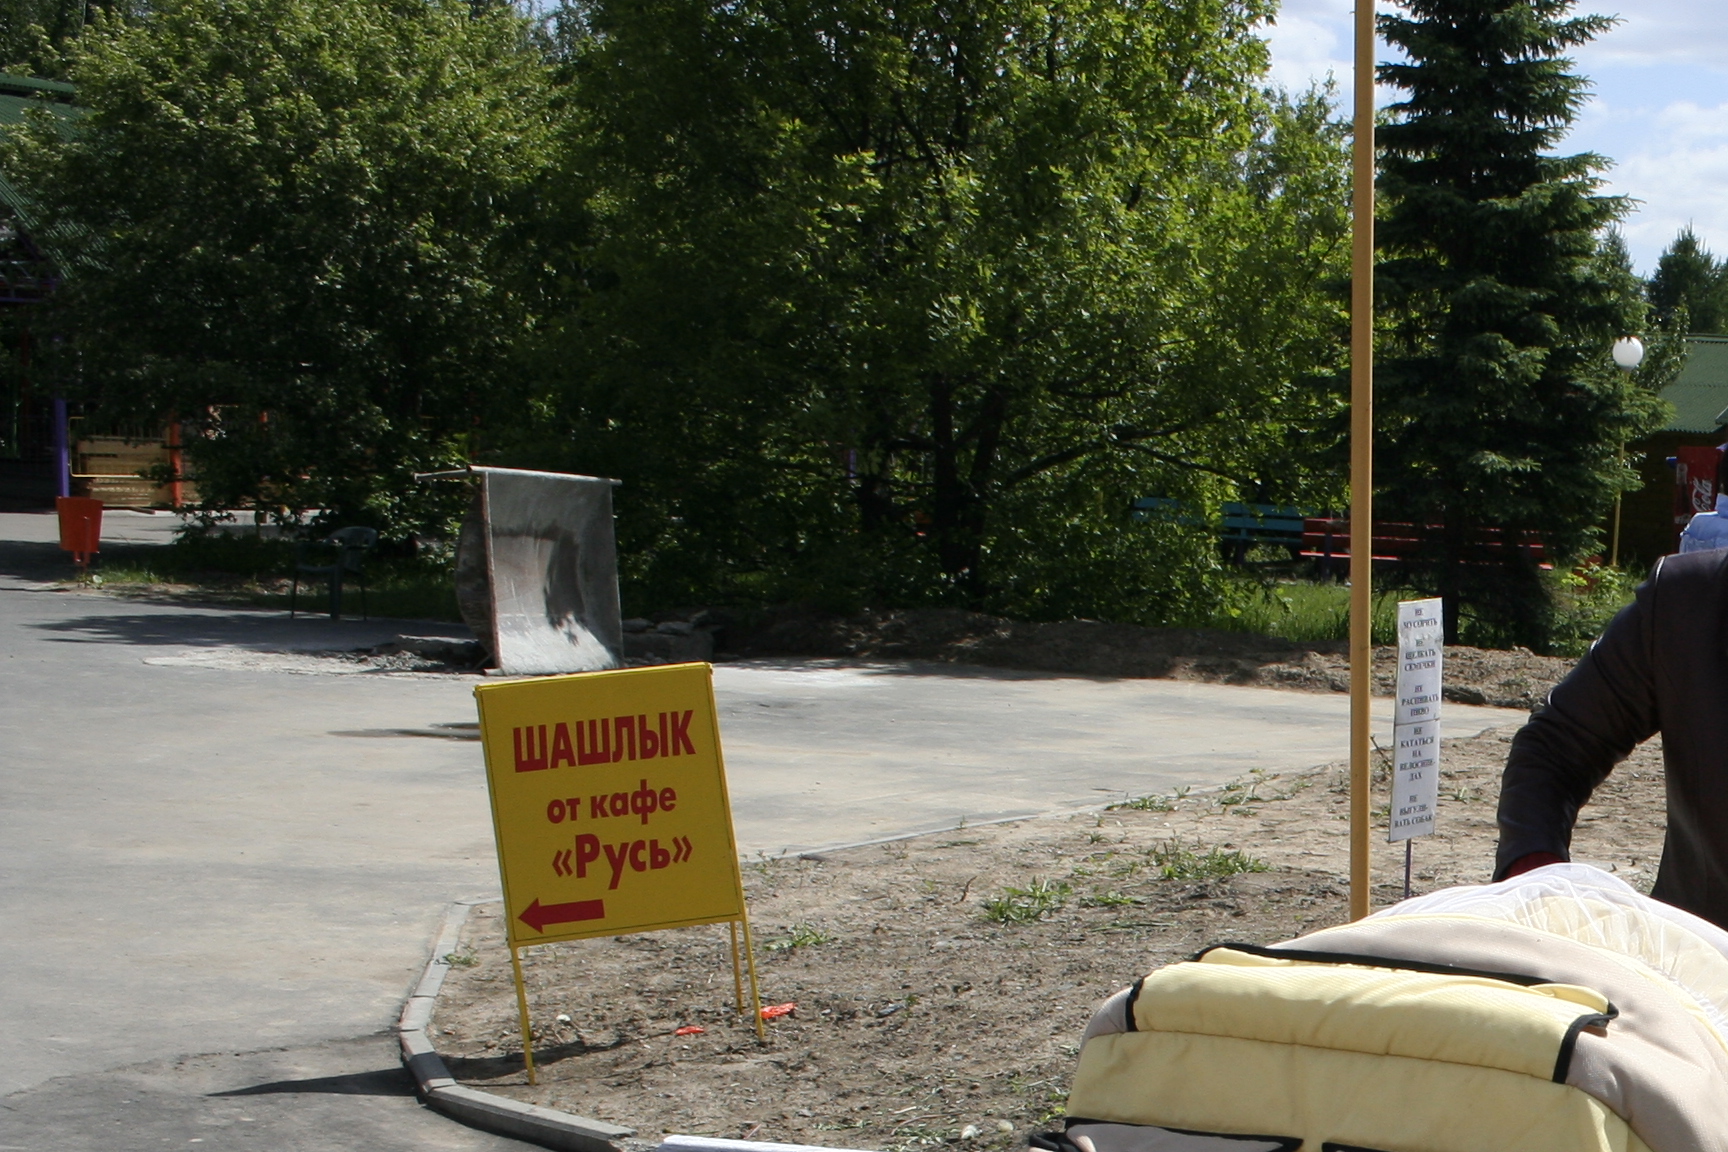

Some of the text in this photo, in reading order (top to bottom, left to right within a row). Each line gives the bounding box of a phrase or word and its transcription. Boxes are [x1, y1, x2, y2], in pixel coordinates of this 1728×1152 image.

[513, 709, 697, 773] ШАШЛЫК
[547, 779, 677, 825] от кафе
[552, 833, 693, 890] «Русь»
